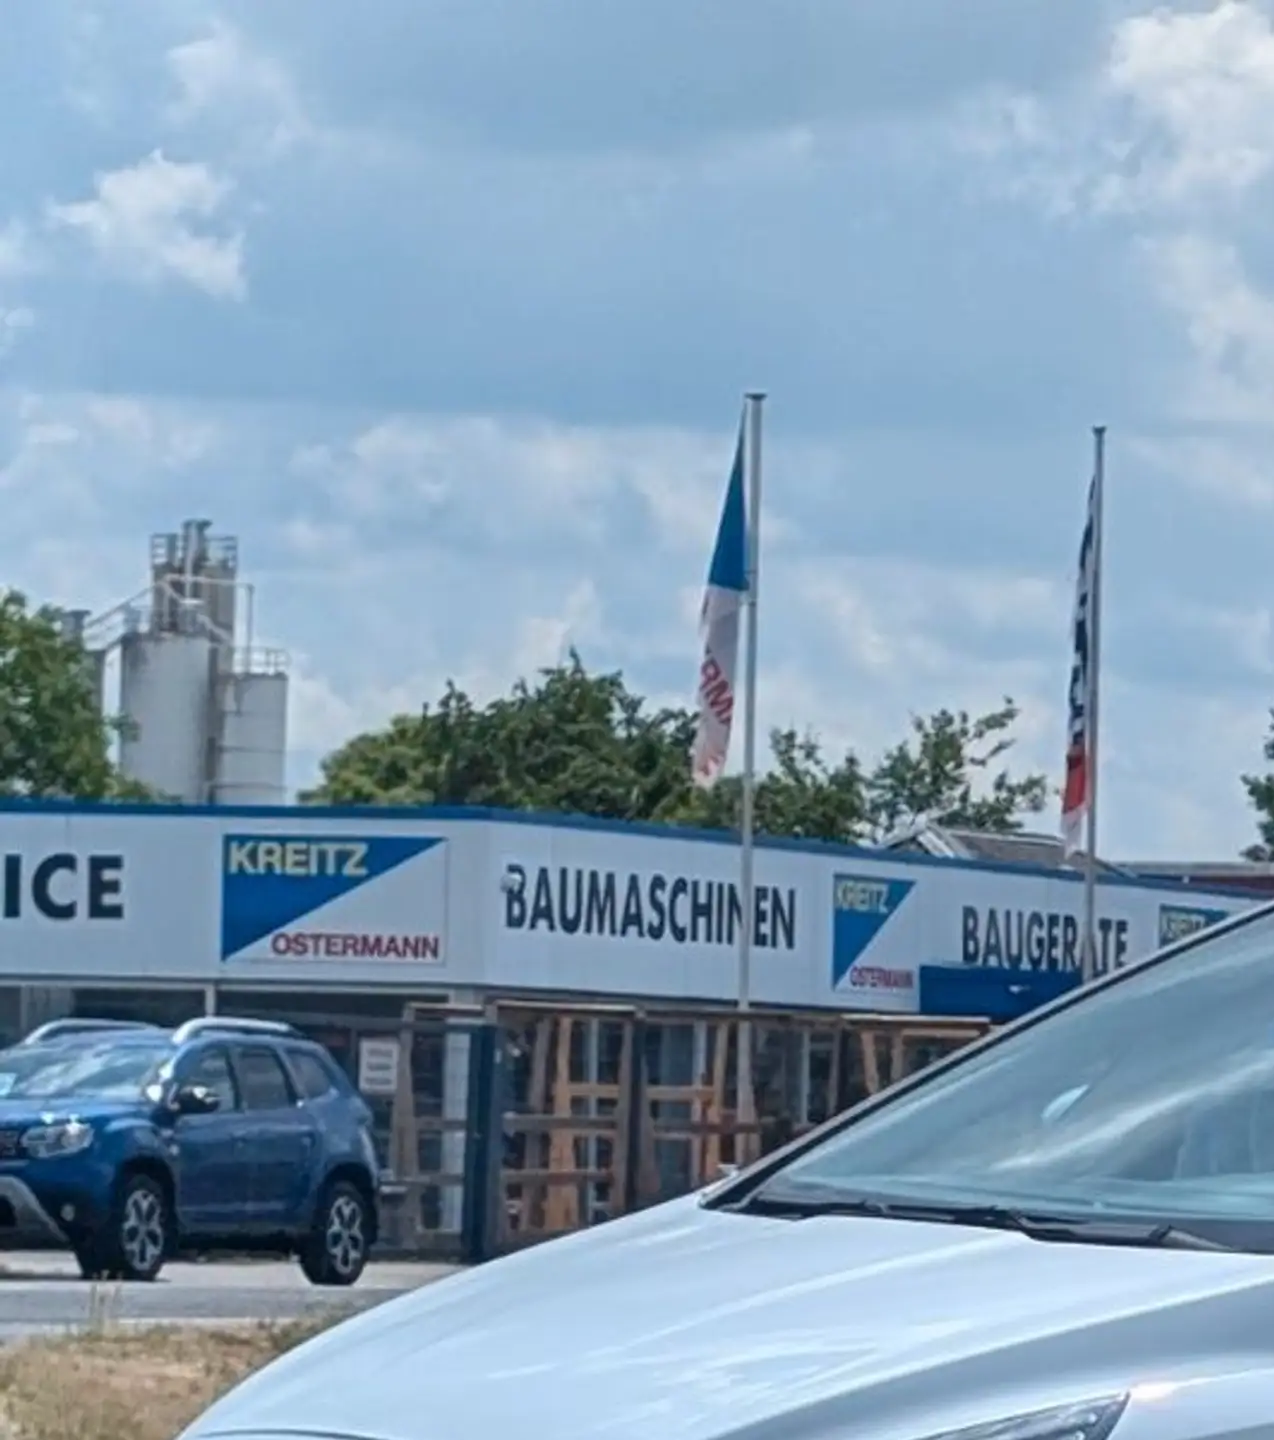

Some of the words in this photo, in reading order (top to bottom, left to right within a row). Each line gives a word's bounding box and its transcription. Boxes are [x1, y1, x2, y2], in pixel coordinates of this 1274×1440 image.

[228, 842, 369, 877] KREITZ
[3, 853, 124, 920] ICE
[504, 864, 796, 949] BAUMASCHINEN
[271, 932, 439, 960] OSTERMANN
